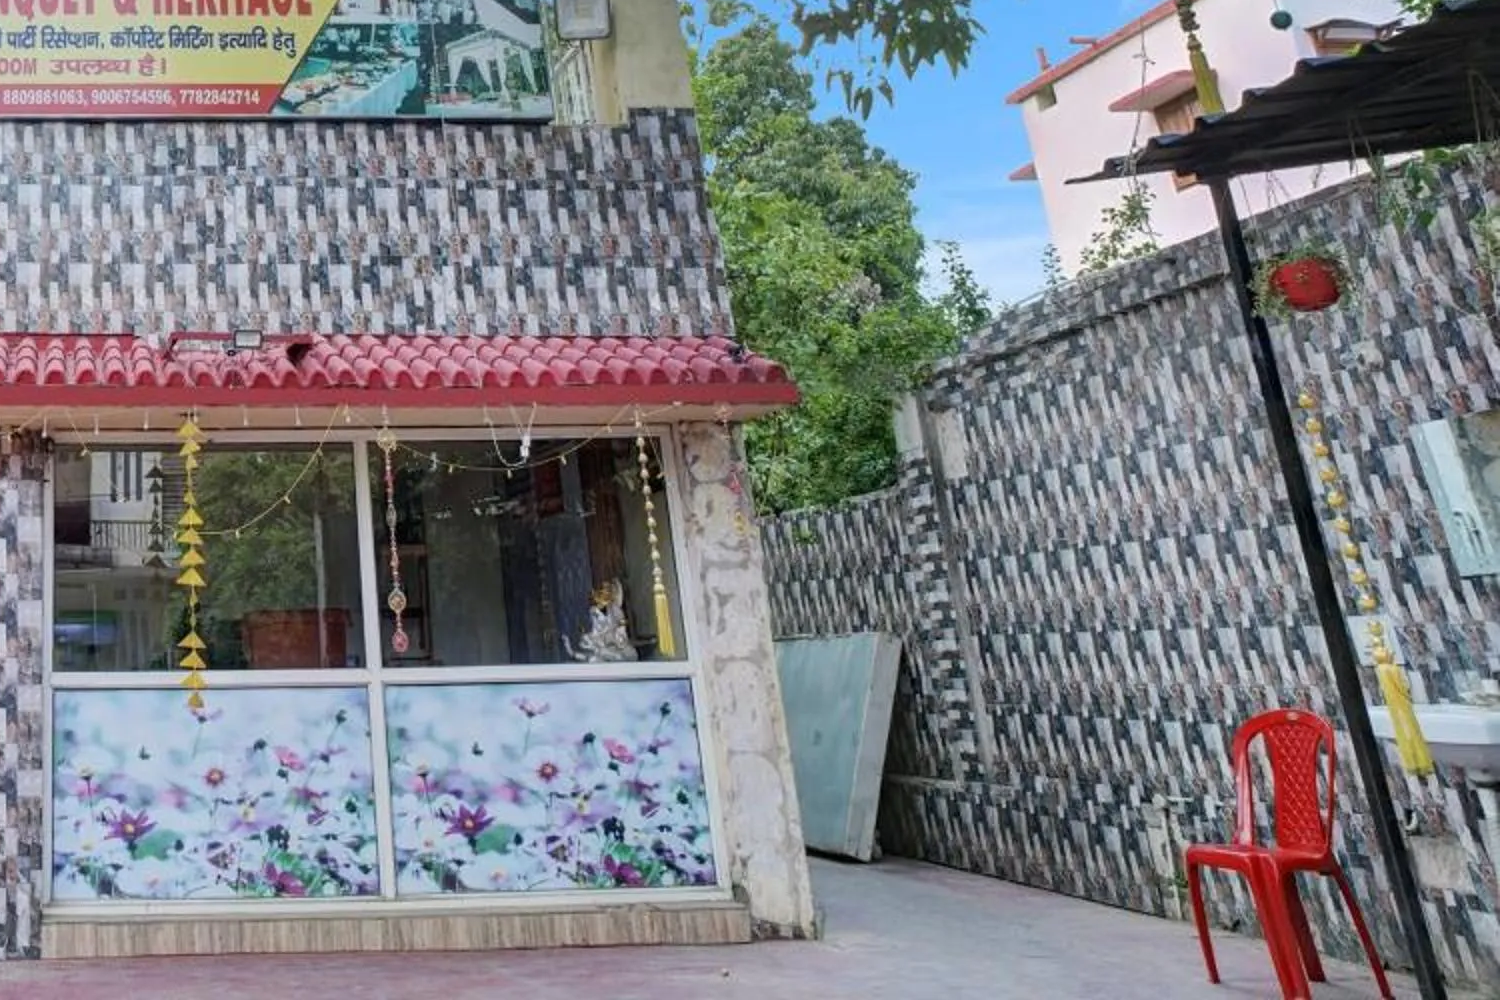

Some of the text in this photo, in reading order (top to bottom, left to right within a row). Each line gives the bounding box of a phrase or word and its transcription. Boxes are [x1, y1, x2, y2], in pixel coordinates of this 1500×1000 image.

[7, 24, 37, 49] पार्टी
[218, 25, 268, 51] इत्यादि
[272, 26, 297, 58] हेतु
[179, 89, 260, 105] 7782842714
